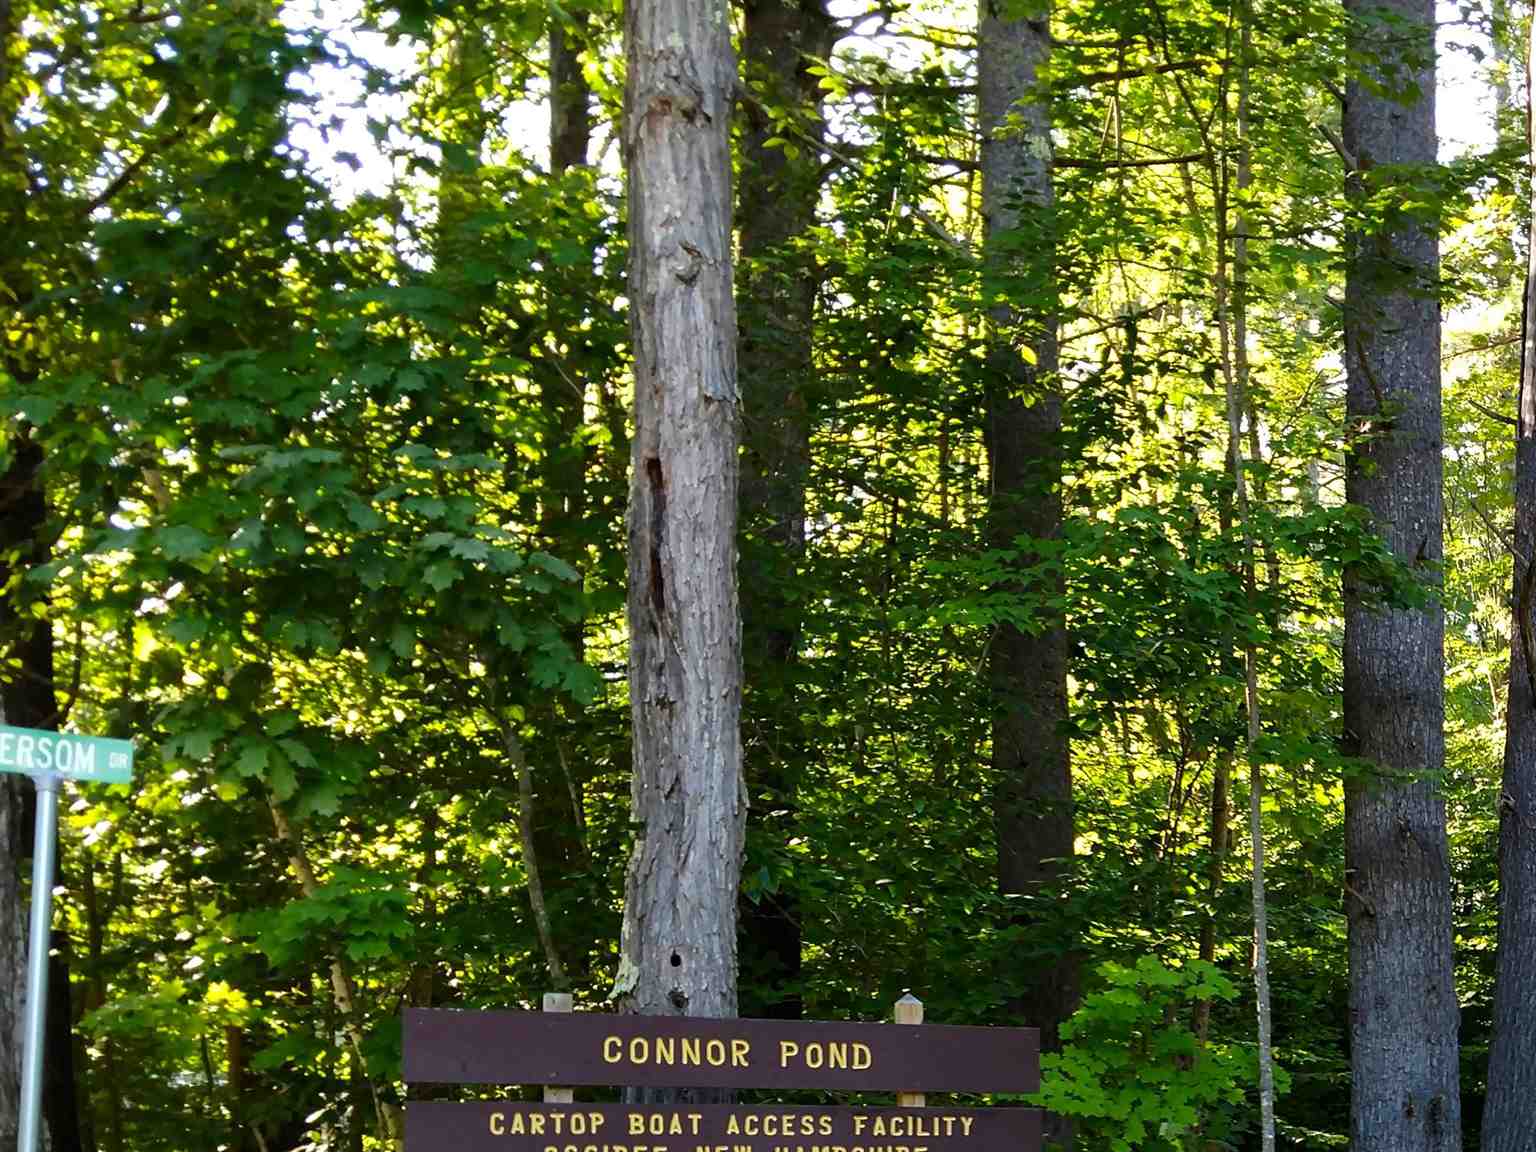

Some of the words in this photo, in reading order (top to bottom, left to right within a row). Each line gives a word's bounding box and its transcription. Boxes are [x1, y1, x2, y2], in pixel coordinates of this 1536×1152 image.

[0, 732, 95, 774] ERSOM
[603, 1036, 750, 1067] CONNOR
[779, 1040, 872, 1070] POND
[489, 1112, 605, 1136] CARTOP
[628, 1113, 702, 1136] BOAT
[726, 1114, 833, 1136] ACCESS
[853, 1115, 974, 1137] FACILITY
